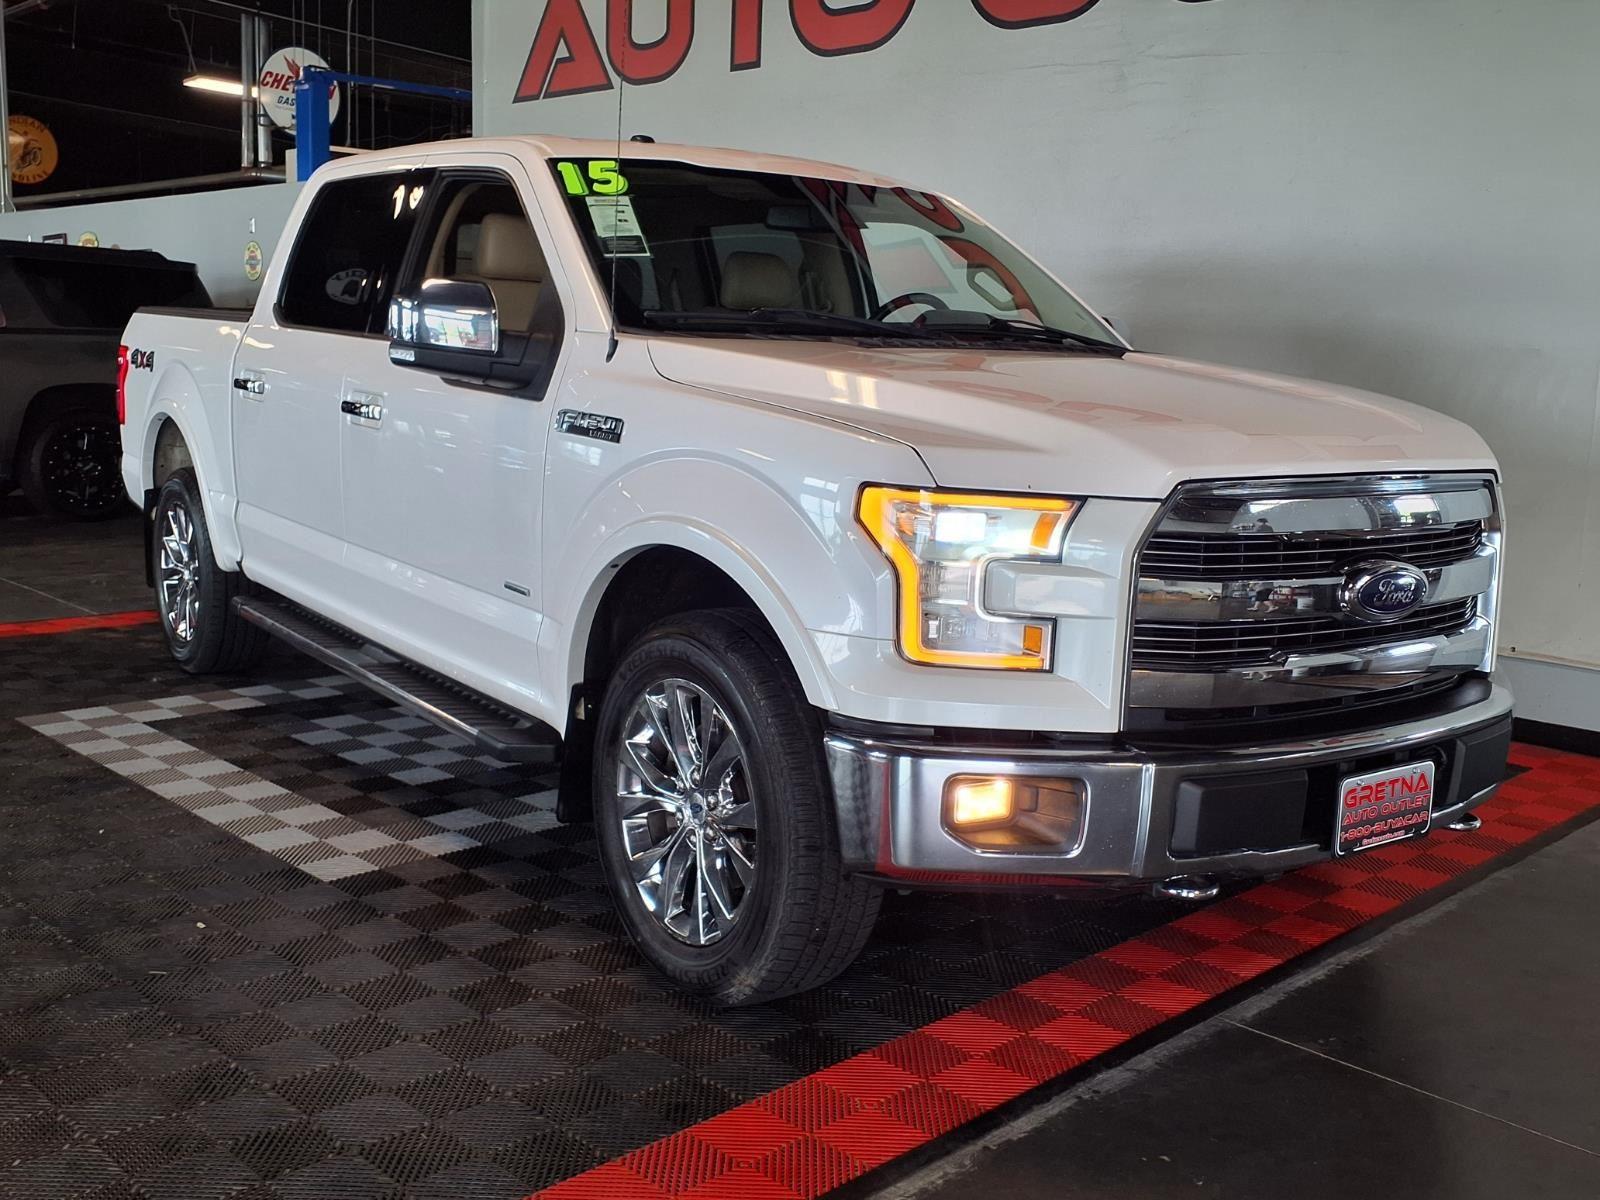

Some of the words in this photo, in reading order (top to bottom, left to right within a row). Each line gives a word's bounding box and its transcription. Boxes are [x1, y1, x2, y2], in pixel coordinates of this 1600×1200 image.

[557, 160, 629, 196] 15
[1374, 577, 1417, 605] Ford
[1344, 772, 1429, 809] GRETNA
[1340, 810, 1429, 843] 1-800-BUYACAR
[1342, 806, 1379, 826] AUTO
[1381, 794, 1430, 815] OUTLET
